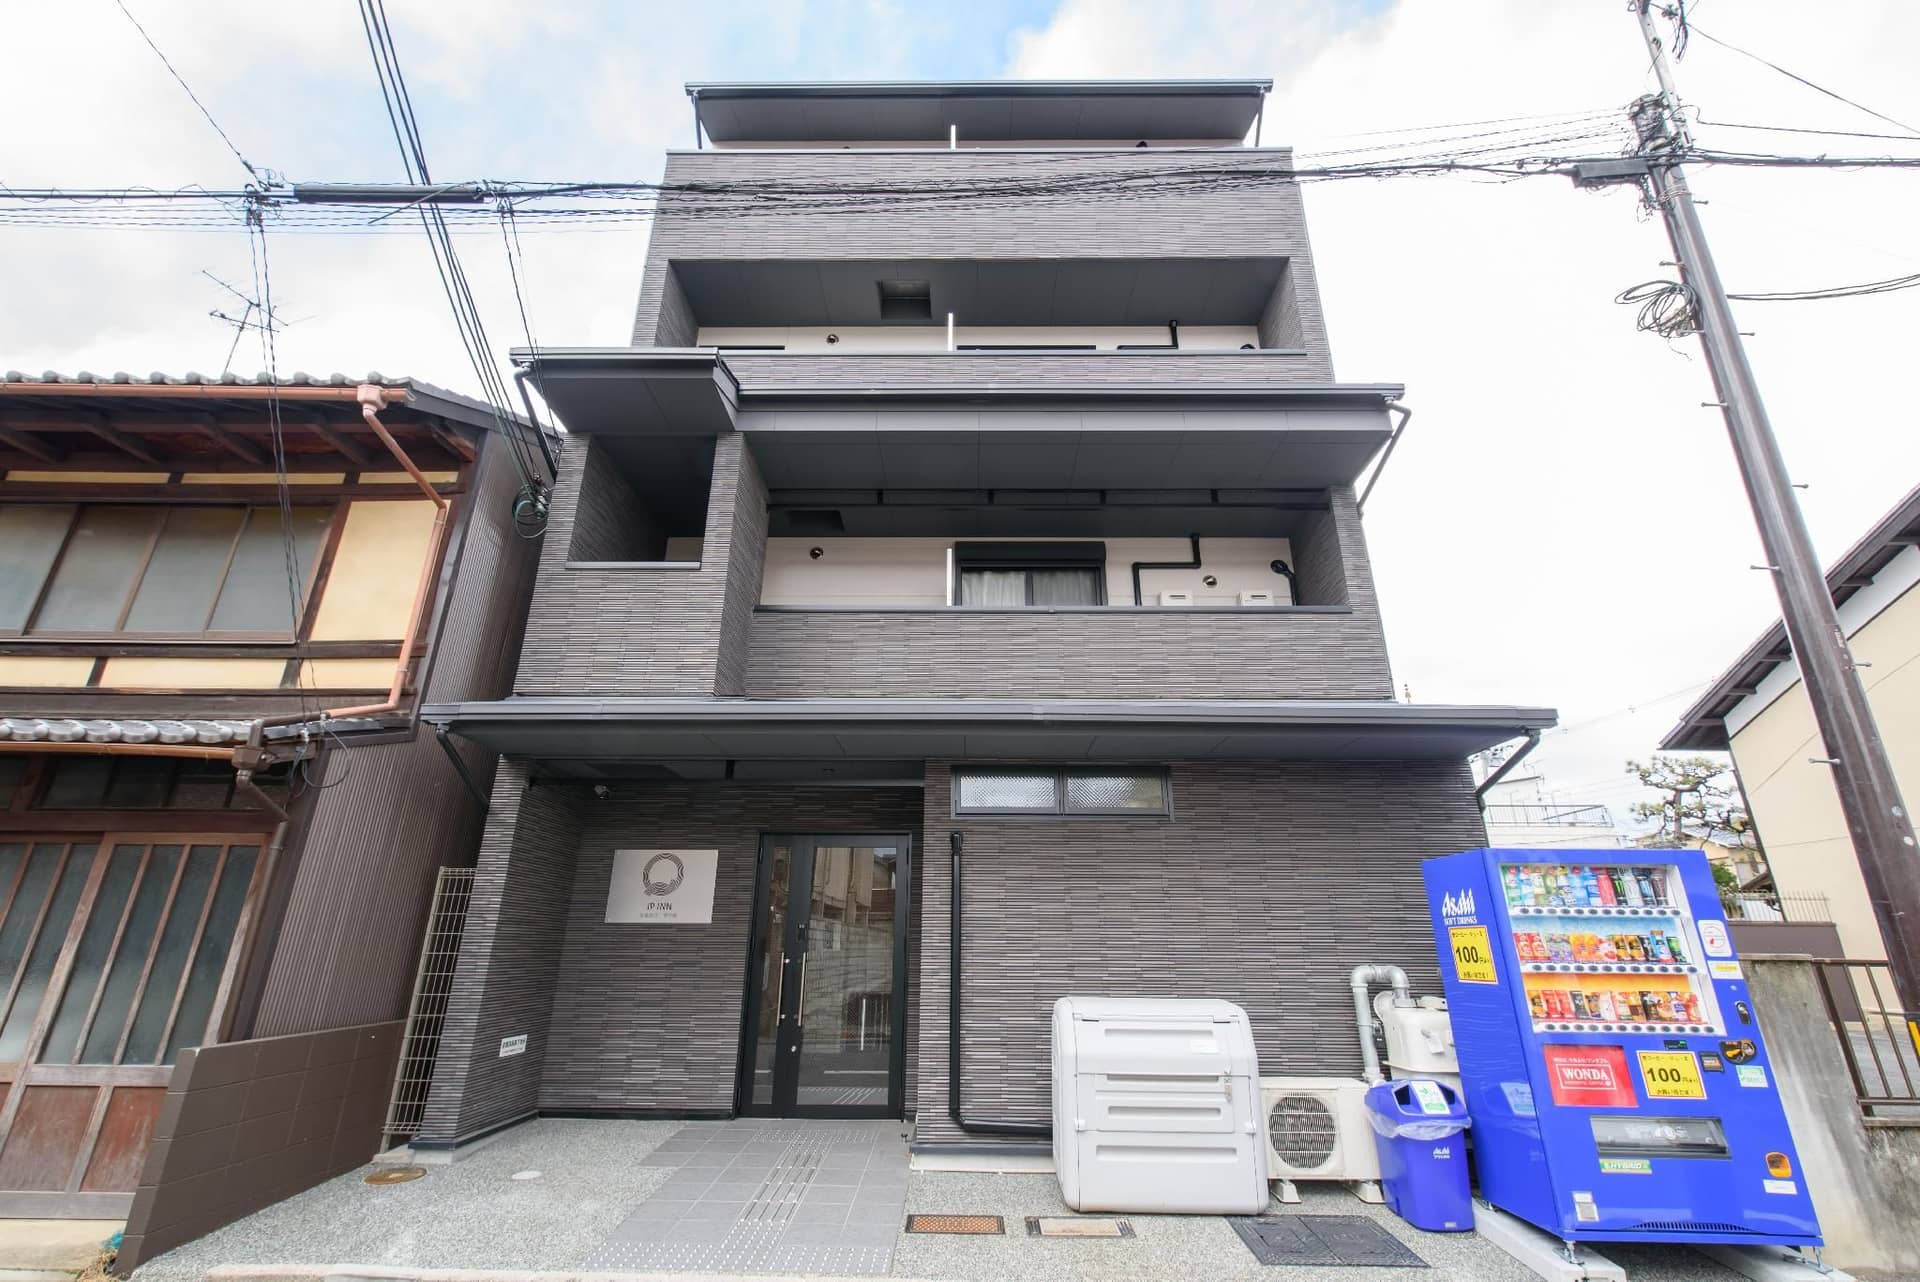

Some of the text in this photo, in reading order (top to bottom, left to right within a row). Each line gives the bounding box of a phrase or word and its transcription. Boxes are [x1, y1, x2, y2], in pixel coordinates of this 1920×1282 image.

[657, 902, 673, 910] INN
[1456, 946, 1479, 963] 100
[1562, 1068, 1610, 1080] WONDA
[1647, 1067, 1681, 1083] 100
